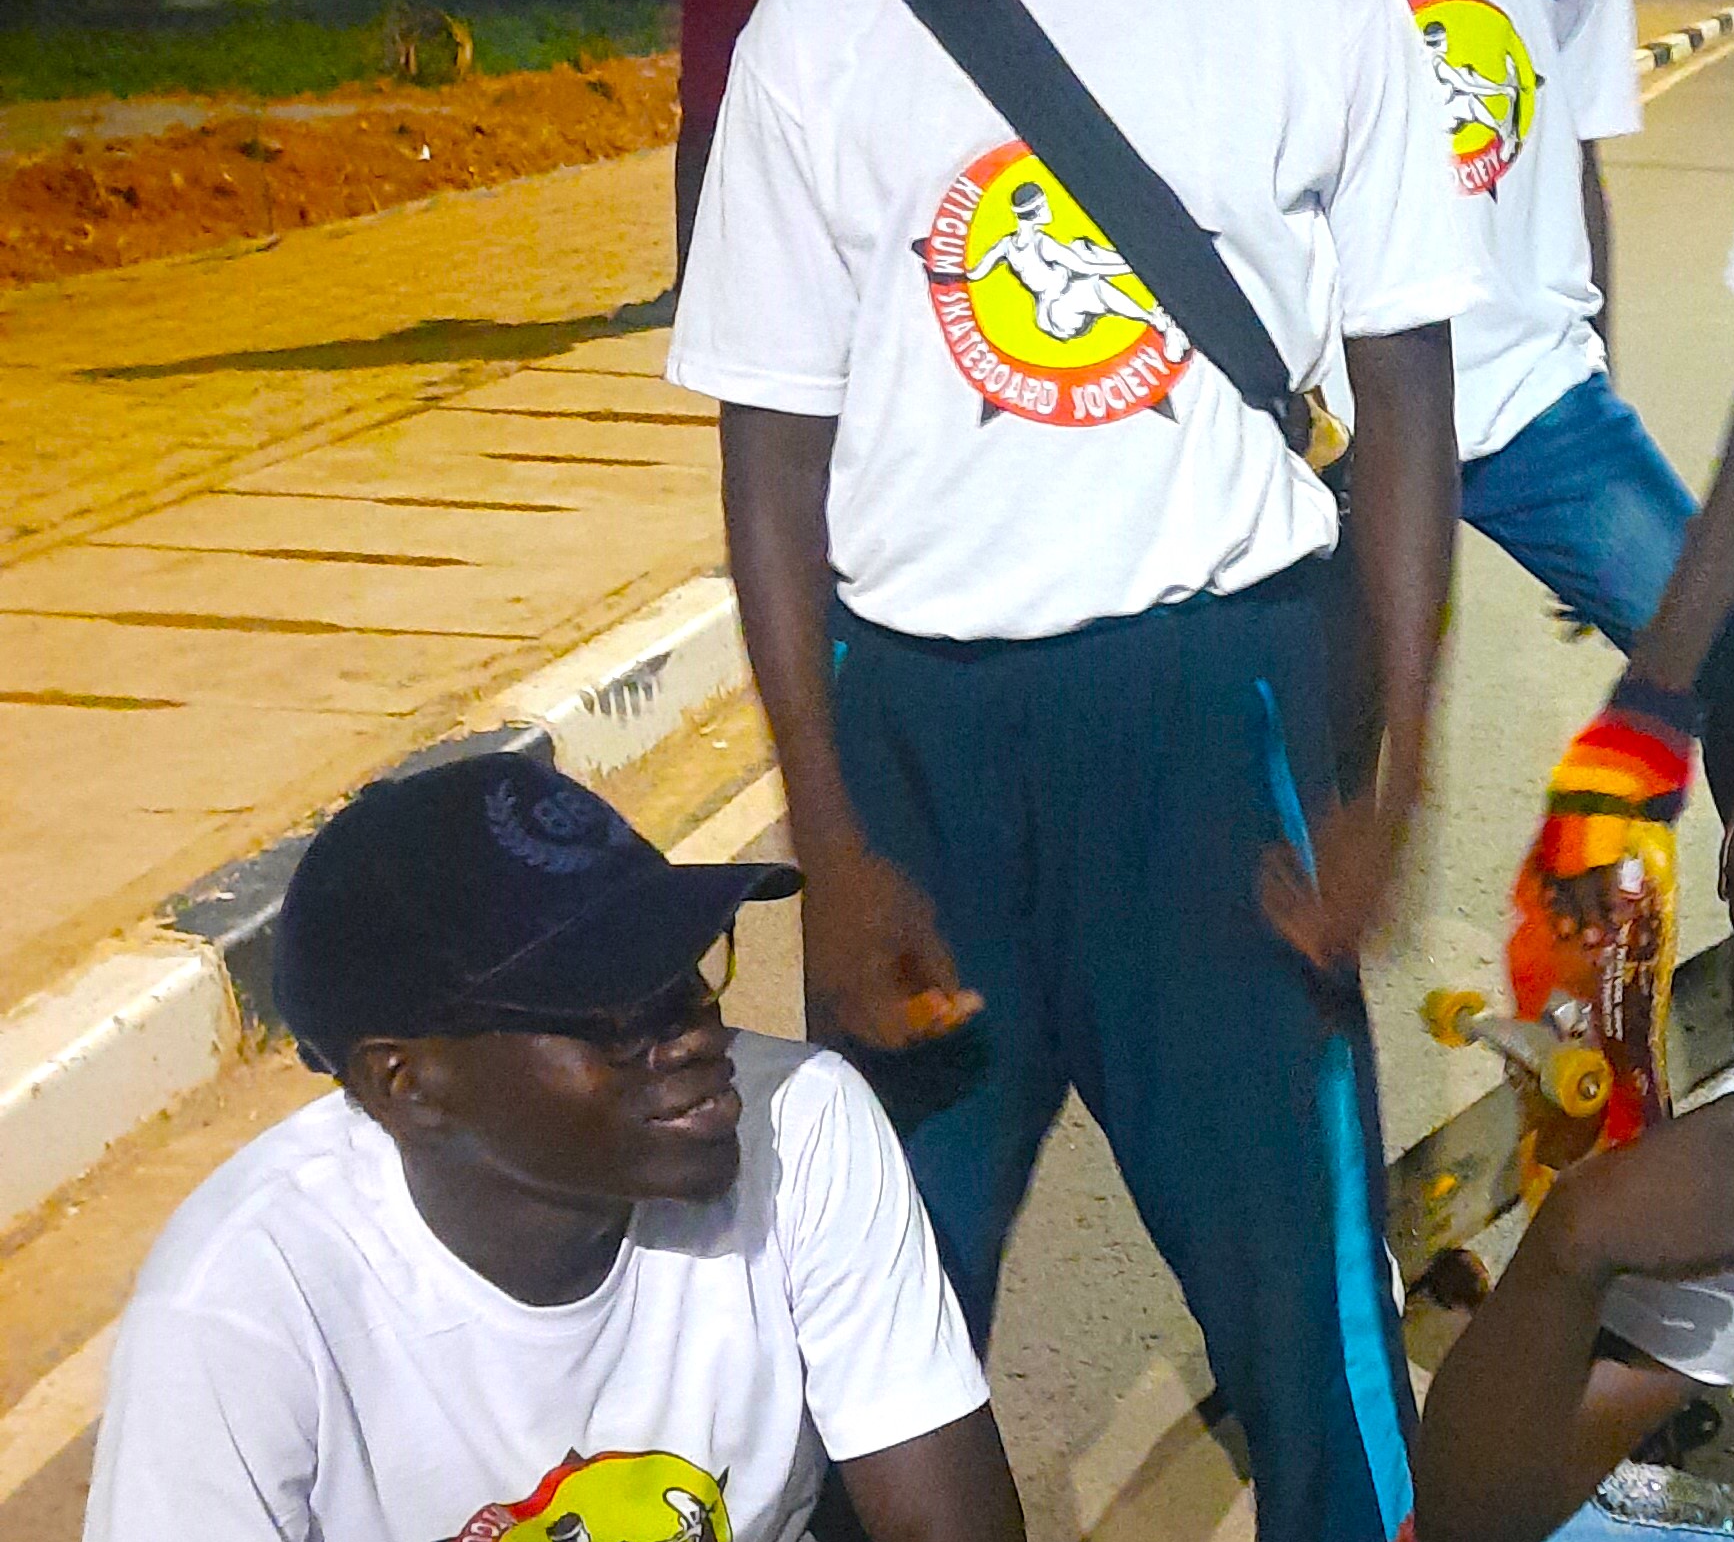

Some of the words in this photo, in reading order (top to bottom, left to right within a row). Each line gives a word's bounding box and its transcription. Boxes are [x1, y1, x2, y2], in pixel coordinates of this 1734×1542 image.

[930, 174, 983, 275] KITGUM
[936, 290, 1059, 416] SKATEBOARD
[1070, 345, 1172, 420] SOCIETY
